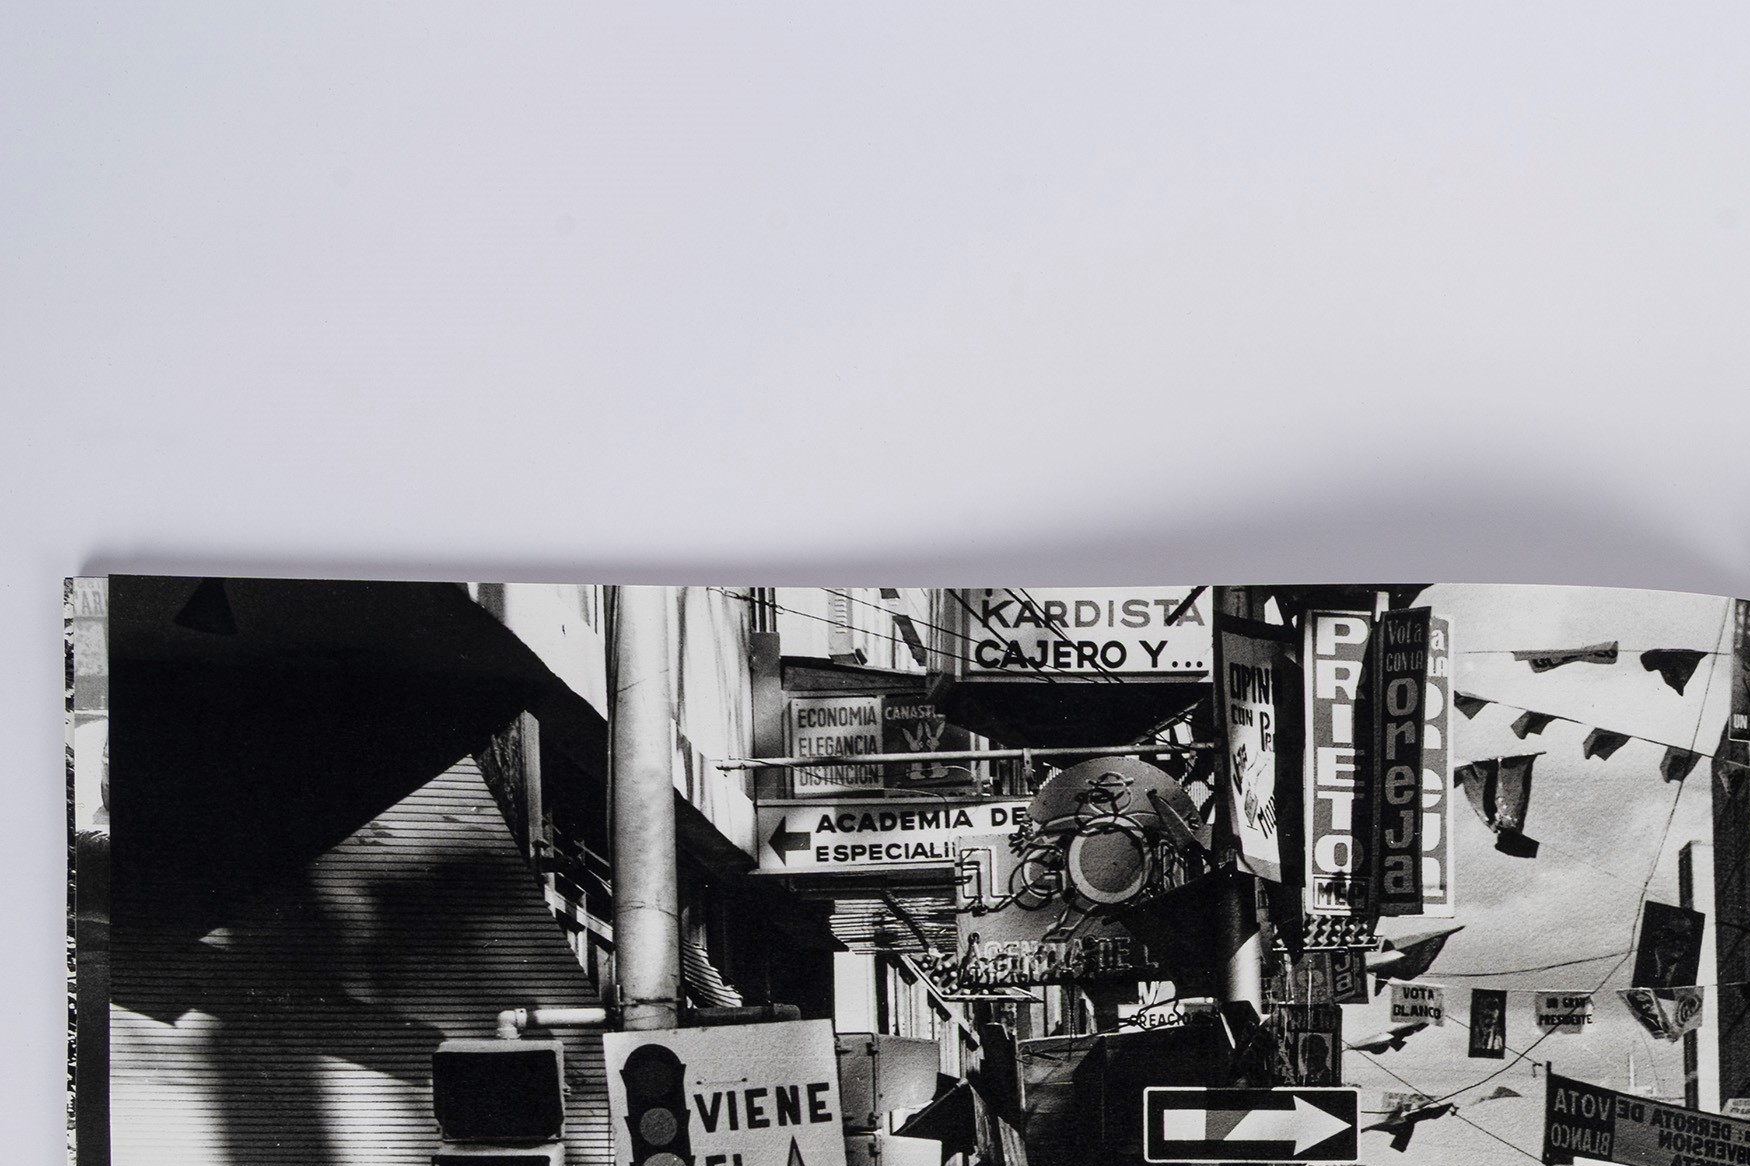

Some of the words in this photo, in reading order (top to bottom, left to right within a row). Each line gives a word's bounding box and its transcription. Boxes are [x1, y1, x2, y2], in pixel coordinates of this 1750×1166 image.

[982, 599, 1206, 628] KARDISTA
[975, 639, 1128, 669] CAJERO
[1230, 662, 1274, 705] OPIN
[798, 705, 878, 728] ECONOMIA
[1733, 714, 1748, 730] UN
[799, 734, 878, 757] ELEGANCIA
[1314, 616, 1369, 873] PRIETO
[816, 809, 973, 834] ACADEMIA
[991, 806, 1028, 827] DE
[1402, 987, 1434, 1000] VOTA
[1392, 1004, 1441, 1020] BLANCO
[693, 1083, 833, 1133] VIENE
